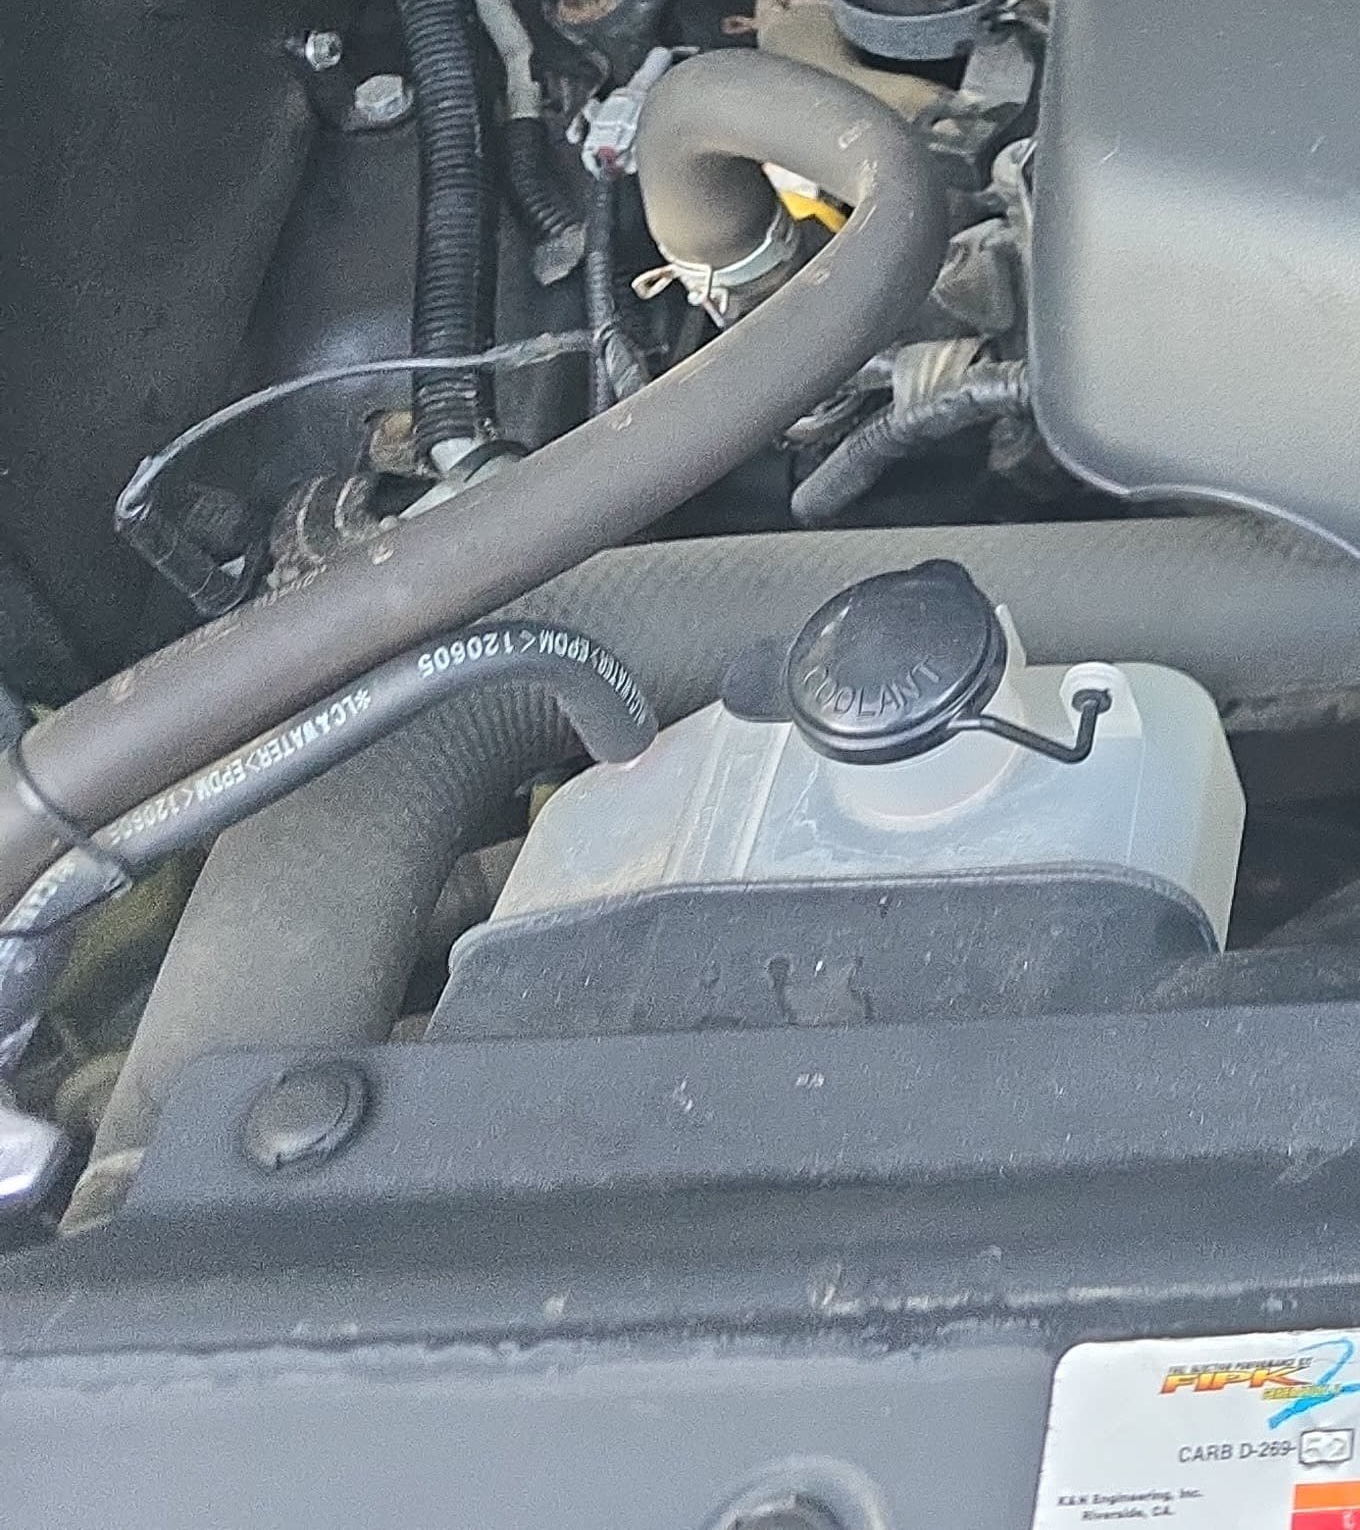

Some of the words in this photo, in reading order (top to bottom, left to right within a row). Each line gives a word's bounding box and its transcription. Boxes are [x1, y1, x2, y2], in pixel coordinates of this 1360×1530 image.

[802, 655, 943, 719] COOLANT
[1159, 1365, 1314, 1394] FIPK
[1178, 1443, 1233, 1463] CARB
